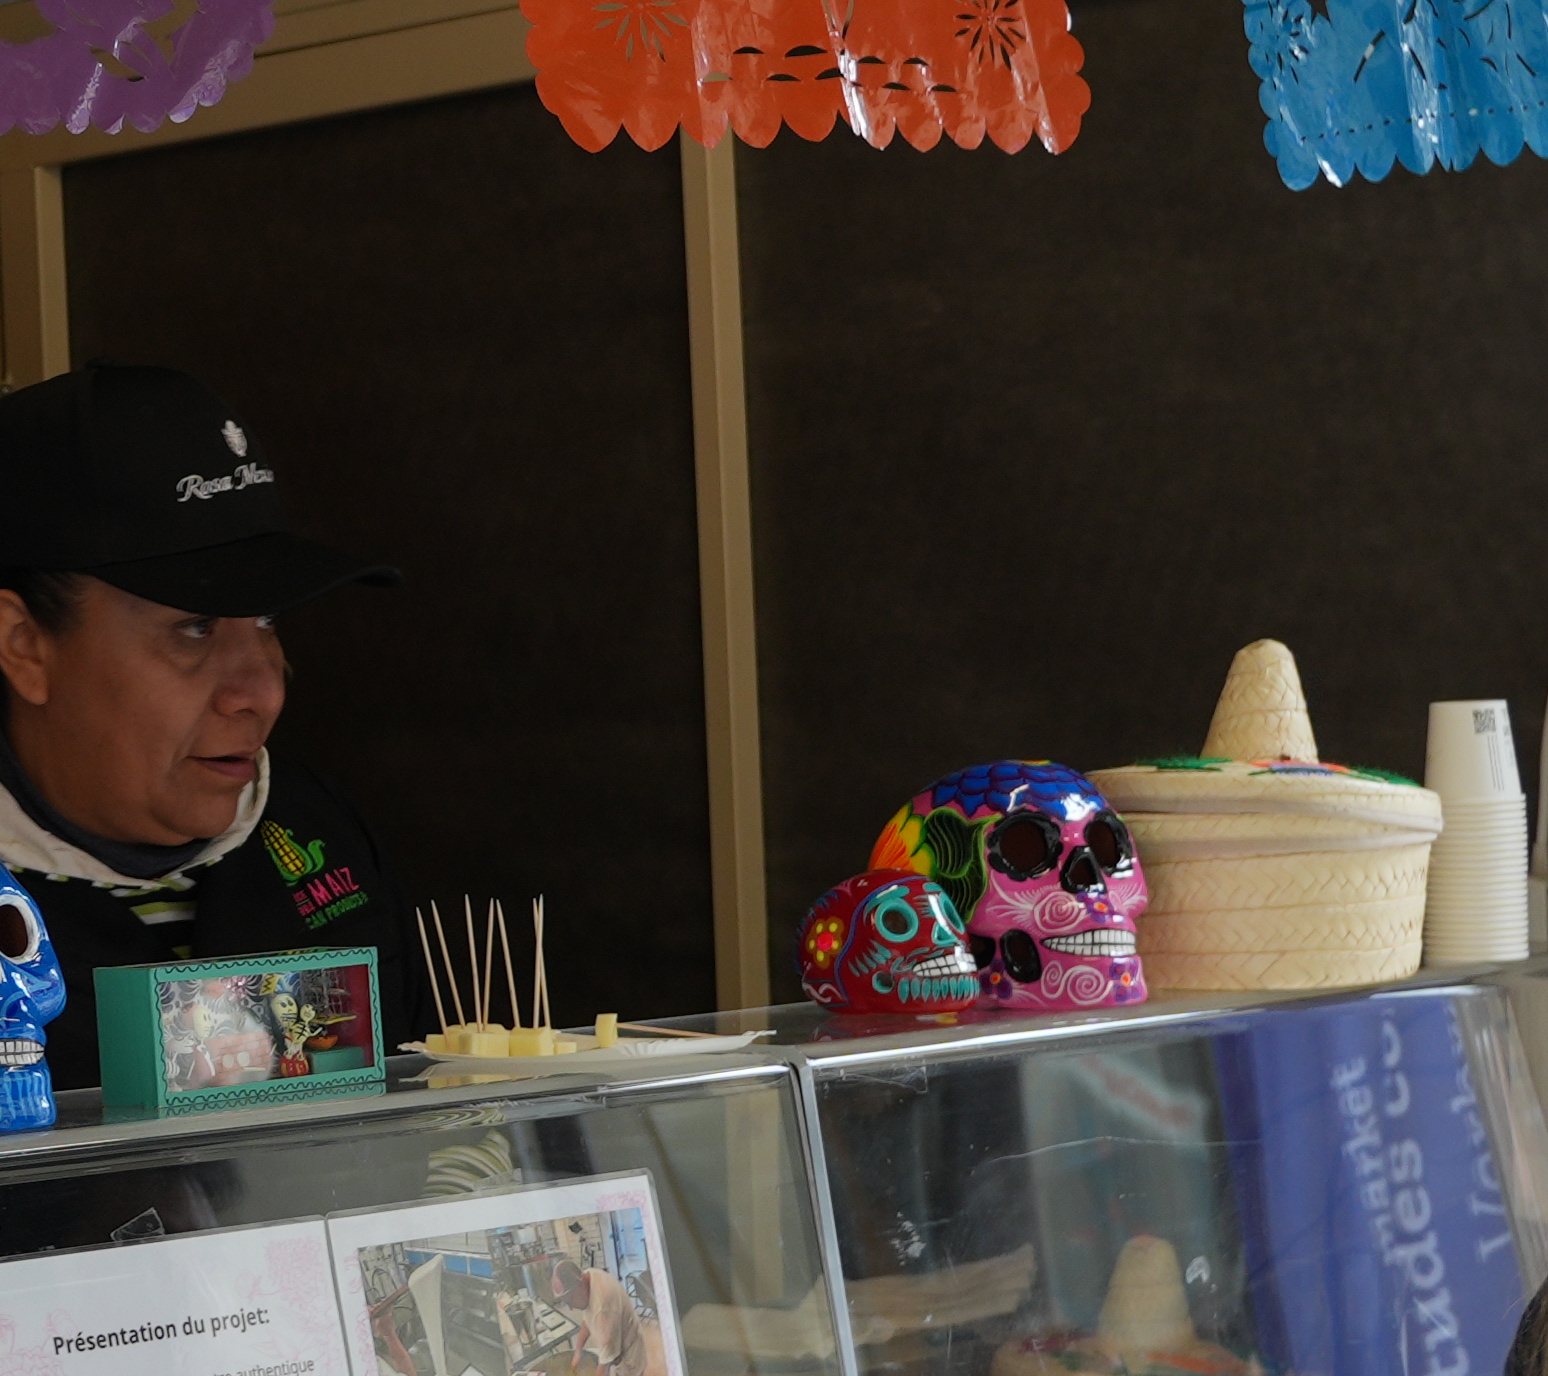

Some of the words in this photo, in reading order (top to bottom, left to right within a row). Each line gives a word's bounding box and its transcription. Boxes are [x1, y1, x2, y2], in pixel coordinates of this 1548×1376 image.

[306, 867, 360, 907] MAIZ
[53, 1322, 177, 1355] Présentation
[182, 1316, 205, 1336] du
[212, 1308, 271, 1341] projet:
